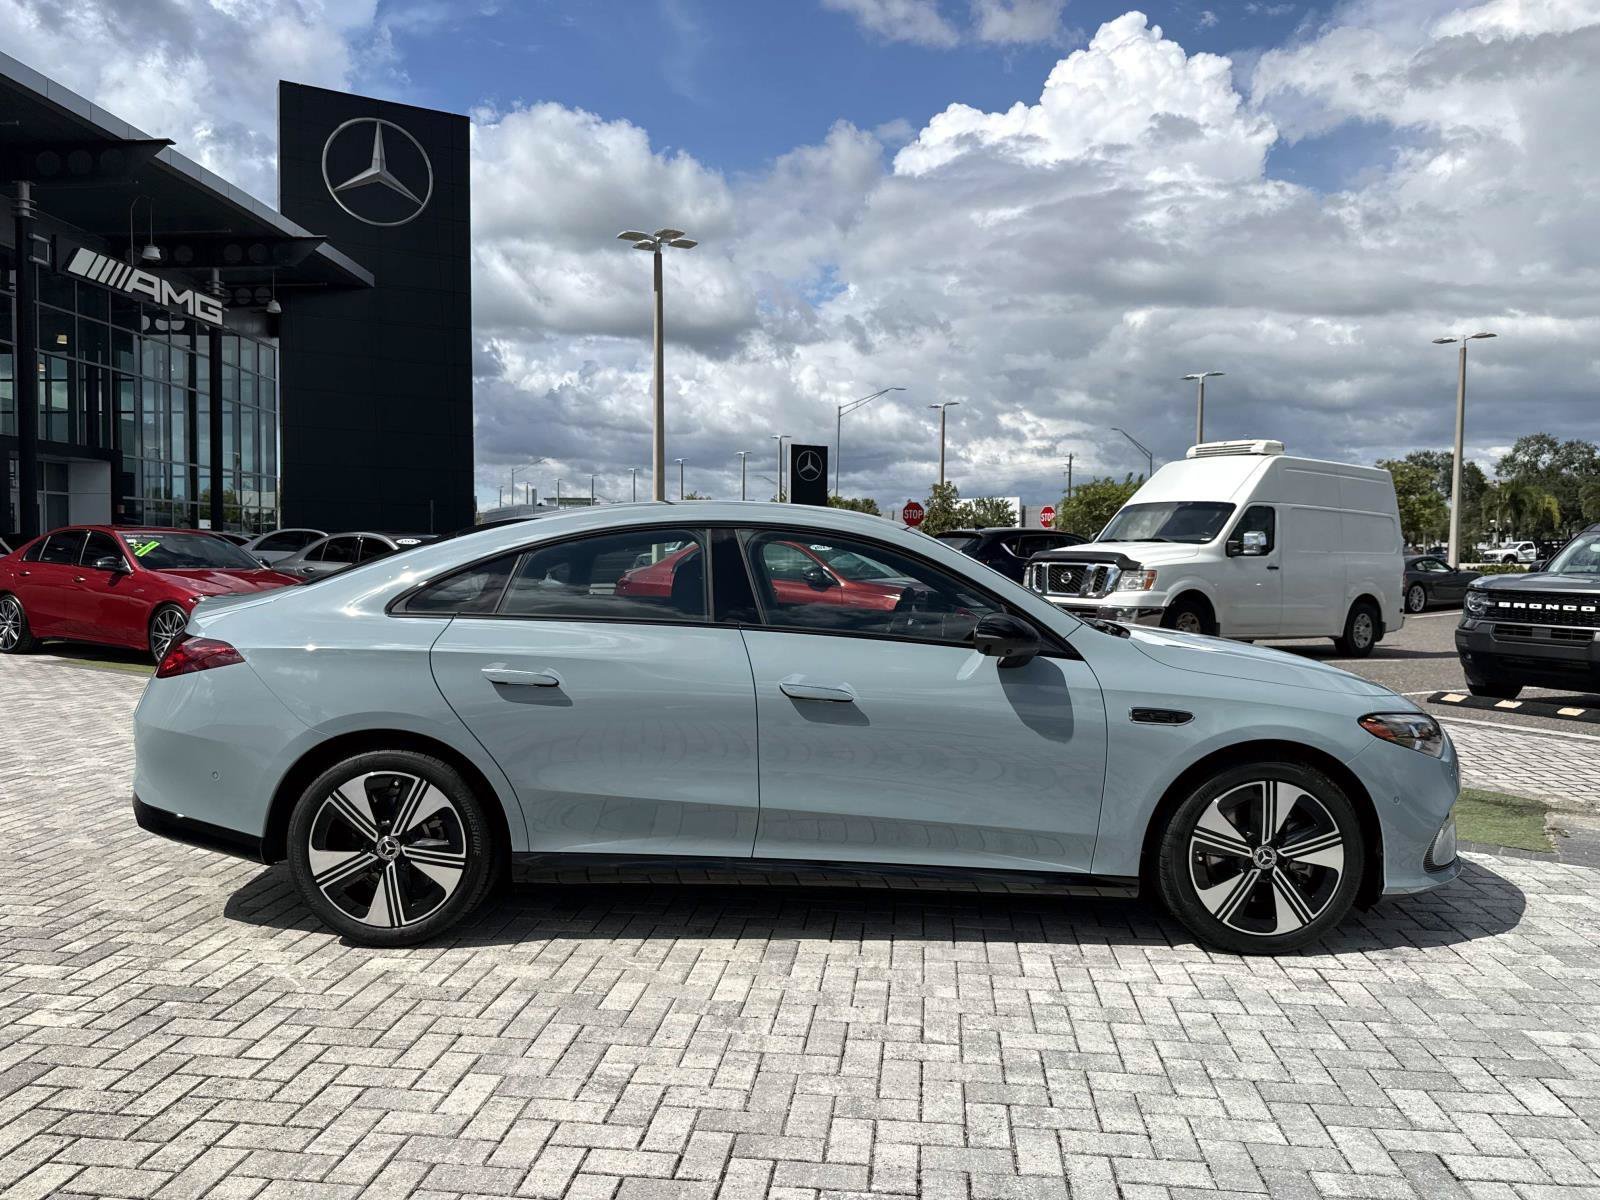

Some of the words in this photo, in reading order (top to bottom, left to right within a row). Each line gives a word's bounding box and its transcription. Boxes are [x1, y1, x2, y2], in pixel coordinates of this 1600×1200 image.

[124, 268, 223, 325] AMG
[904, 510, 923, 519] STOP
[1040, 512, 1056, 521] STOP
[1498, 601, 1596, 612] BRONCO
